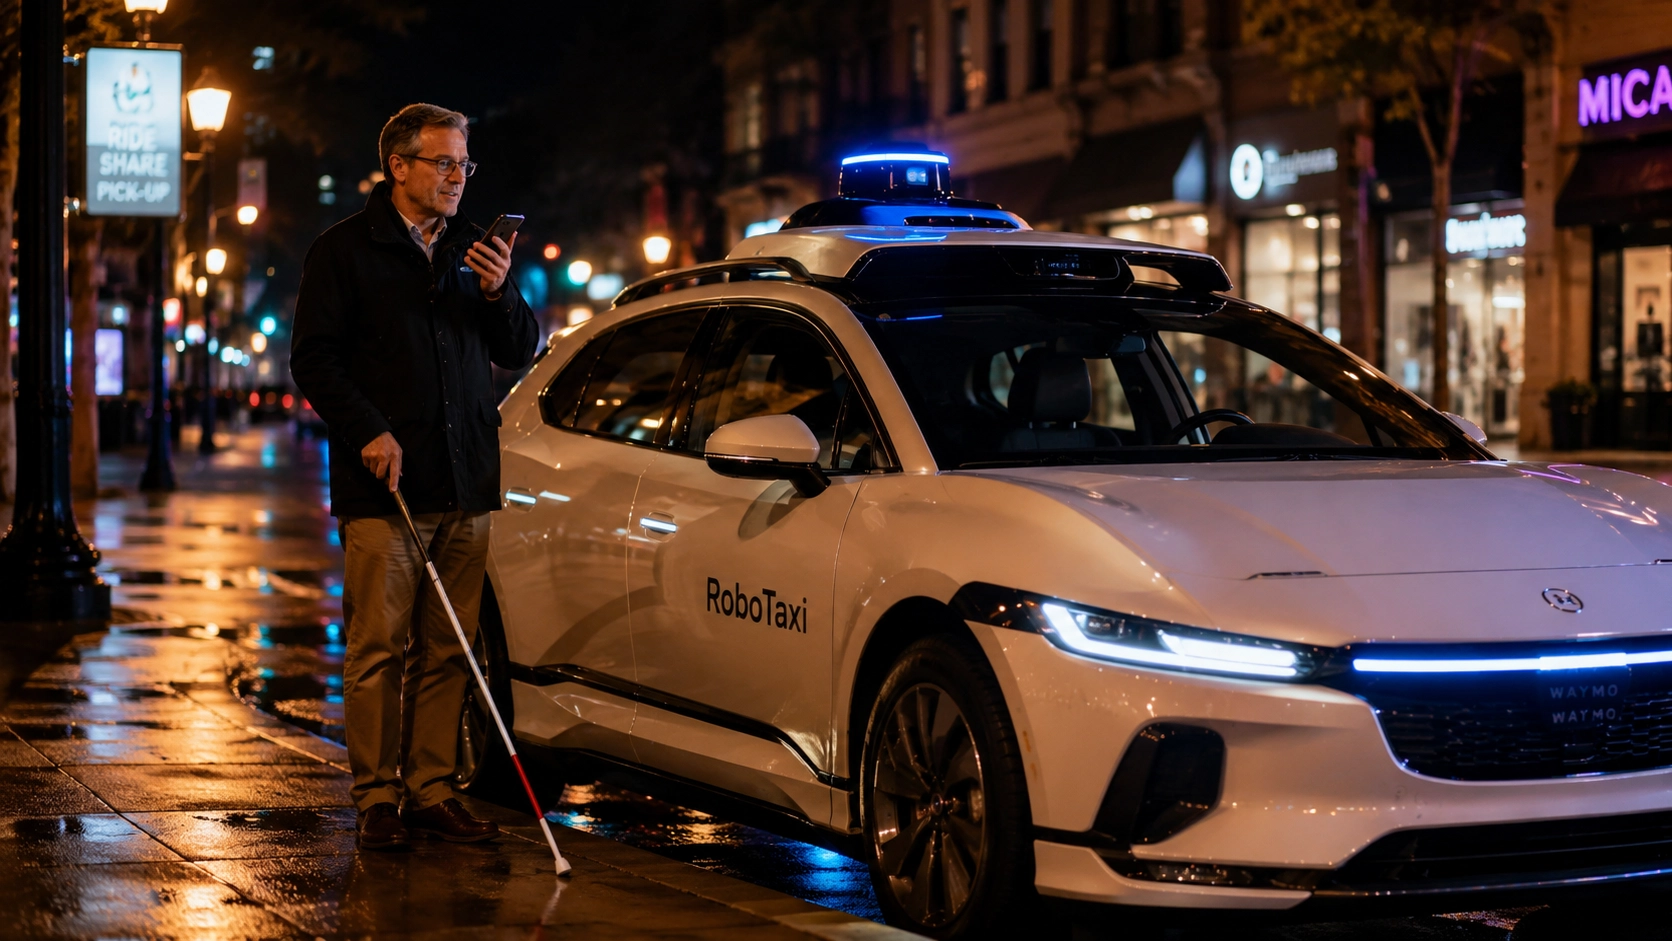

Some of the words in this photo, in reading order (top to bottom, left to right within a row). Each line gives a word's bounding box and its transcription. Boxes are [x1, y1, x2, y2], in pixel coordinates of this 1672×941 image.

[1578, 64, 1672, 127] MICA
[108, 125, 158, 151] RIDE
[99, 152, 169, 177] SHARE
[97, 181, 171, 203] PICK-UP
[707, 576, 807, 634] RoboTaxi
[1550, 684, 1618, 699] WAYMO
[1552, 708, 1616, 724] WAYMO
